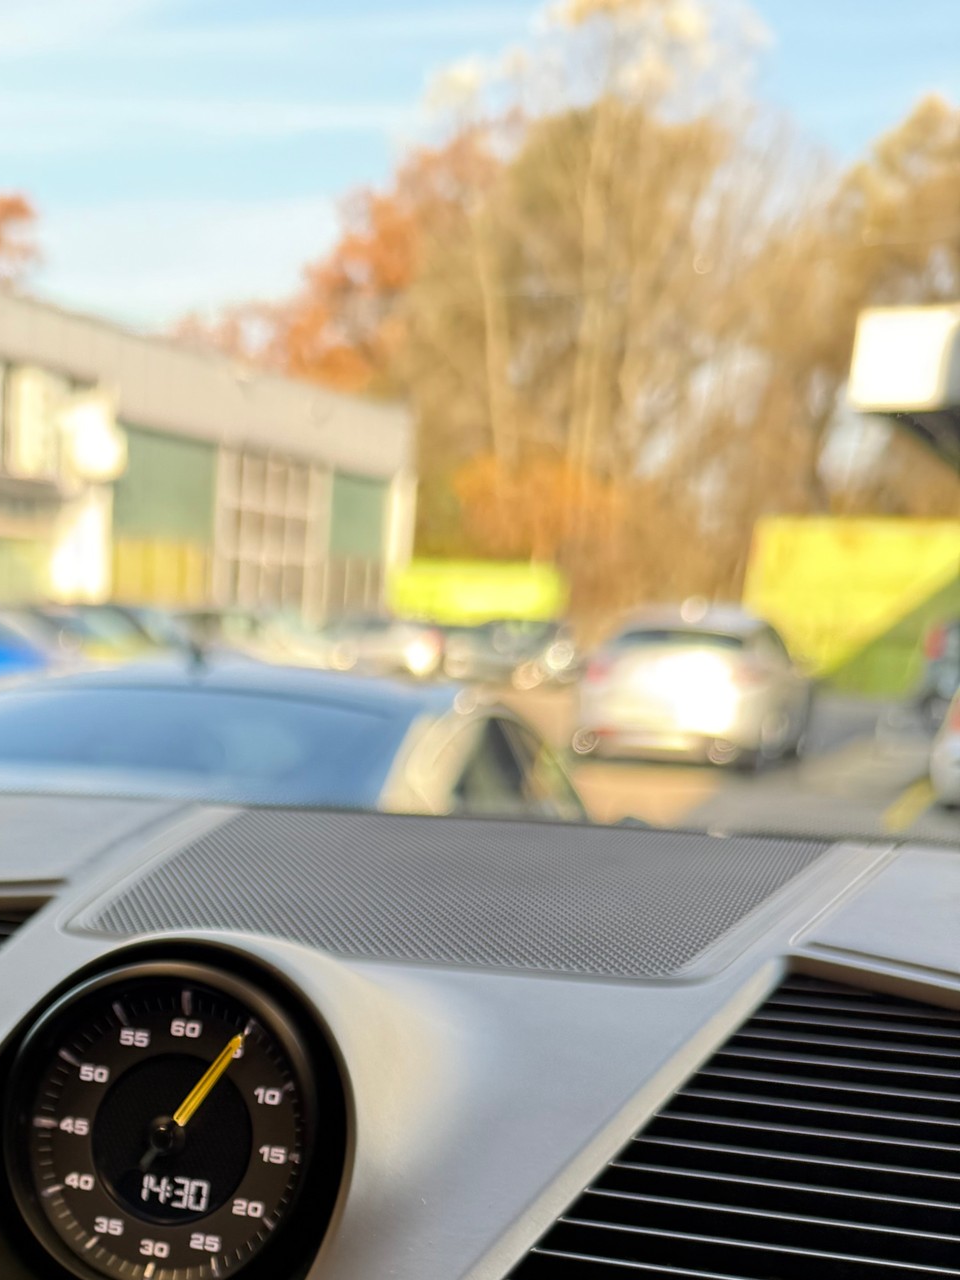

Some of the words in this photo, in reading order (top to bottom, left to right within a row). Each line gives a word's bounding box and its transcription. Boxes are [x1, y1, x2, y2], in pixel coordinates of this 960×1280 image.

[120, 1028, 149, 1048] 55
[171, 1020, 201, 1039] 60
[79, 1067, 109, 1083] 50
[254, 1087, 281, 1106] 10
[59, 1117, 89, 1135] 45
[259, 1146, 287, 1165] 15
[64, 1172, 94, 1191] 40
[141, 1173, 210, 1212] 14:30
[232, 1199, 264, 1218] 20
[94, 1217, 123, 1236] 35
[139, 1240, 169, 1258] 30
[190, 1233, 221, 1252] 25
